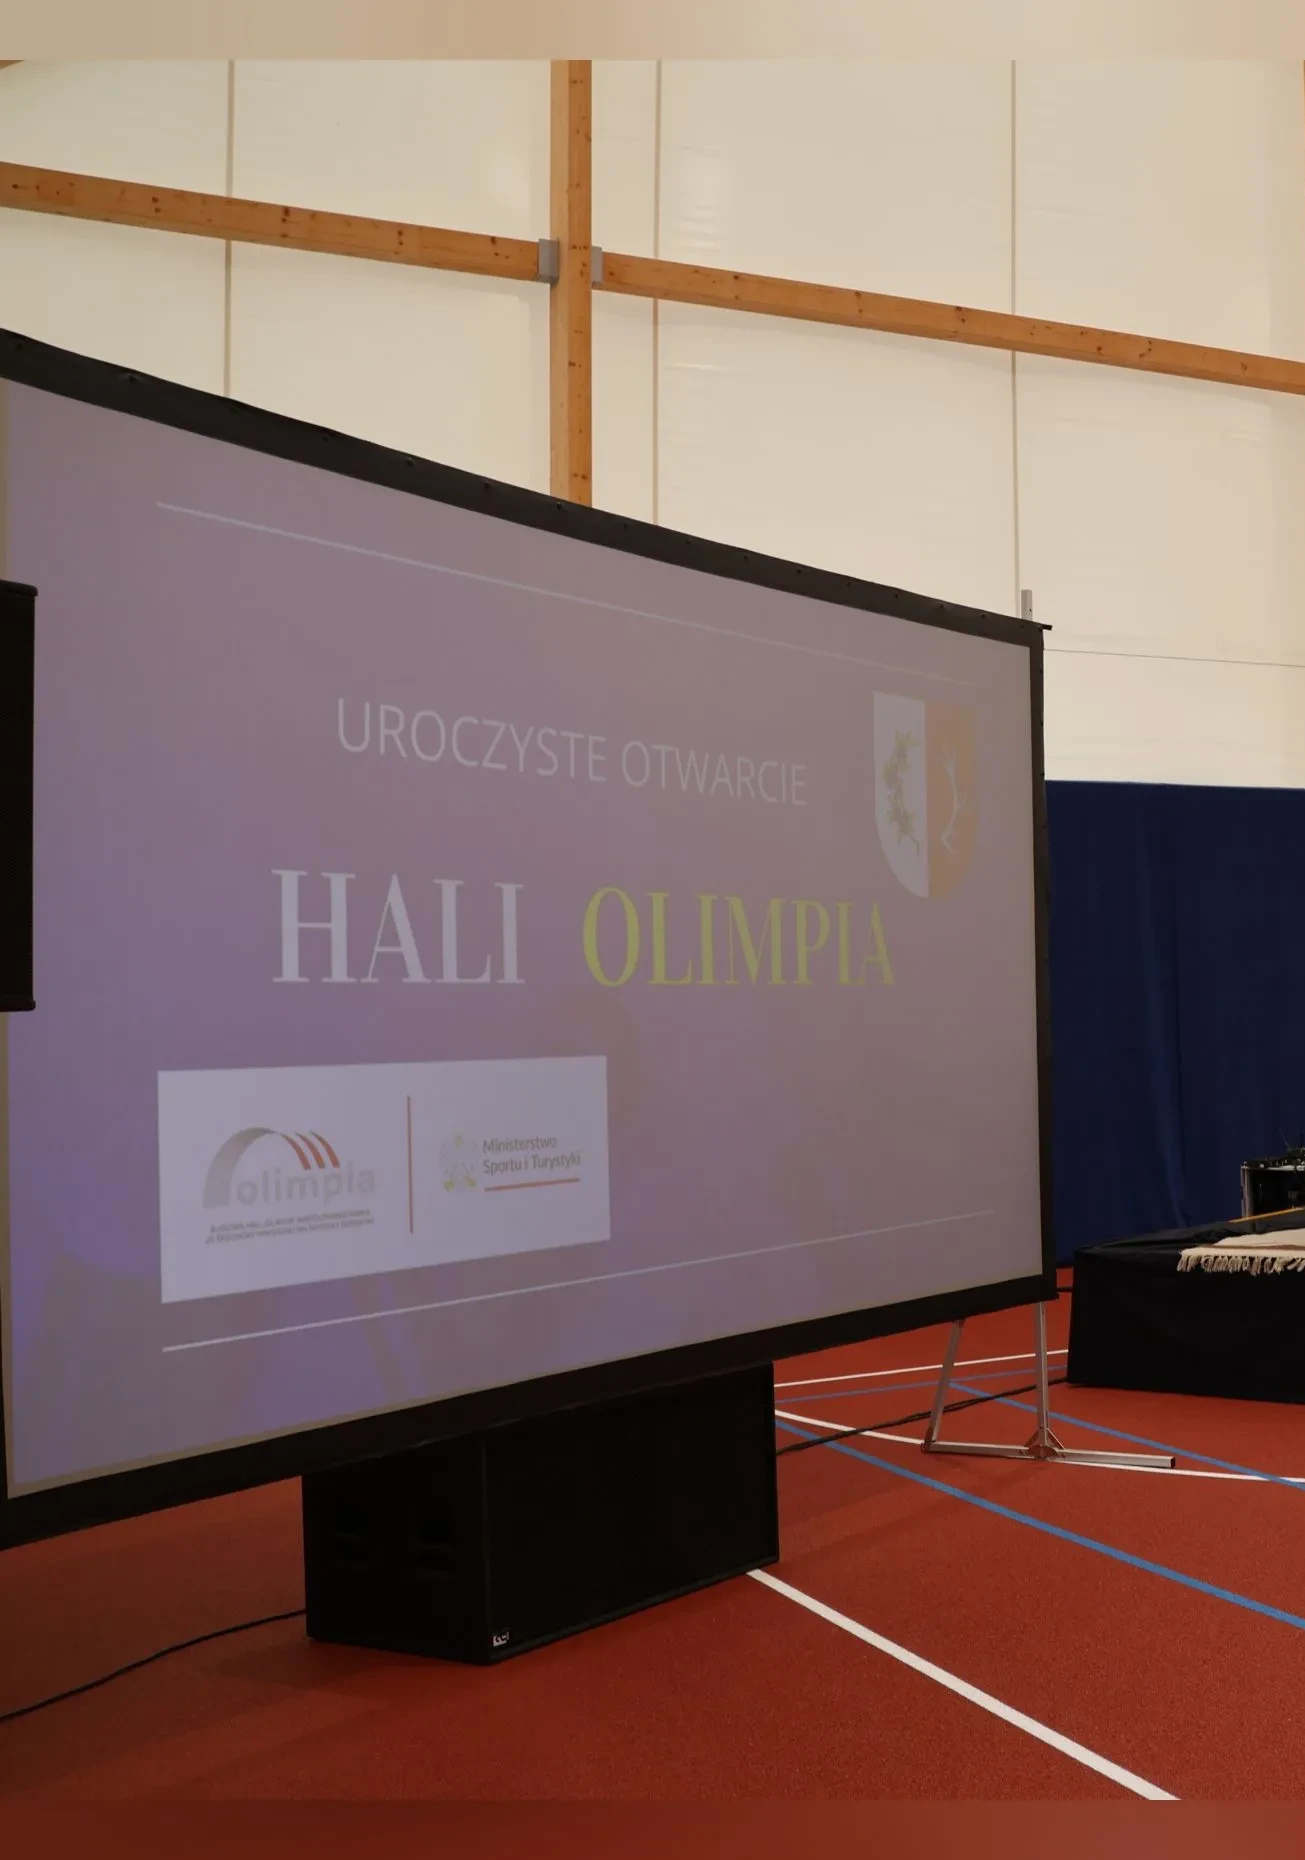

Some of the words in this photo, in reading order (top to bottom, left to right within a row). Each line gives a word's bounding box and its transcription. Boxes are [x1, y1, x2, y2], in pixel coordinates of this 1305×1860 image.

[338, 697, 607, 782] UROCZYSTE
[622, 740, 807, 806] OTWARCIE
[271, 868, 526, 984] HALI
[582, 886, 895, 988] OLIMPIA
[483, 1136, 558, 1154] Ministerstwo
[483, 1158, 521, 1176] Sportu
[532, 1149, 581, 1171] Turystyki
[235, 1159, 375, 1206] olimpia
